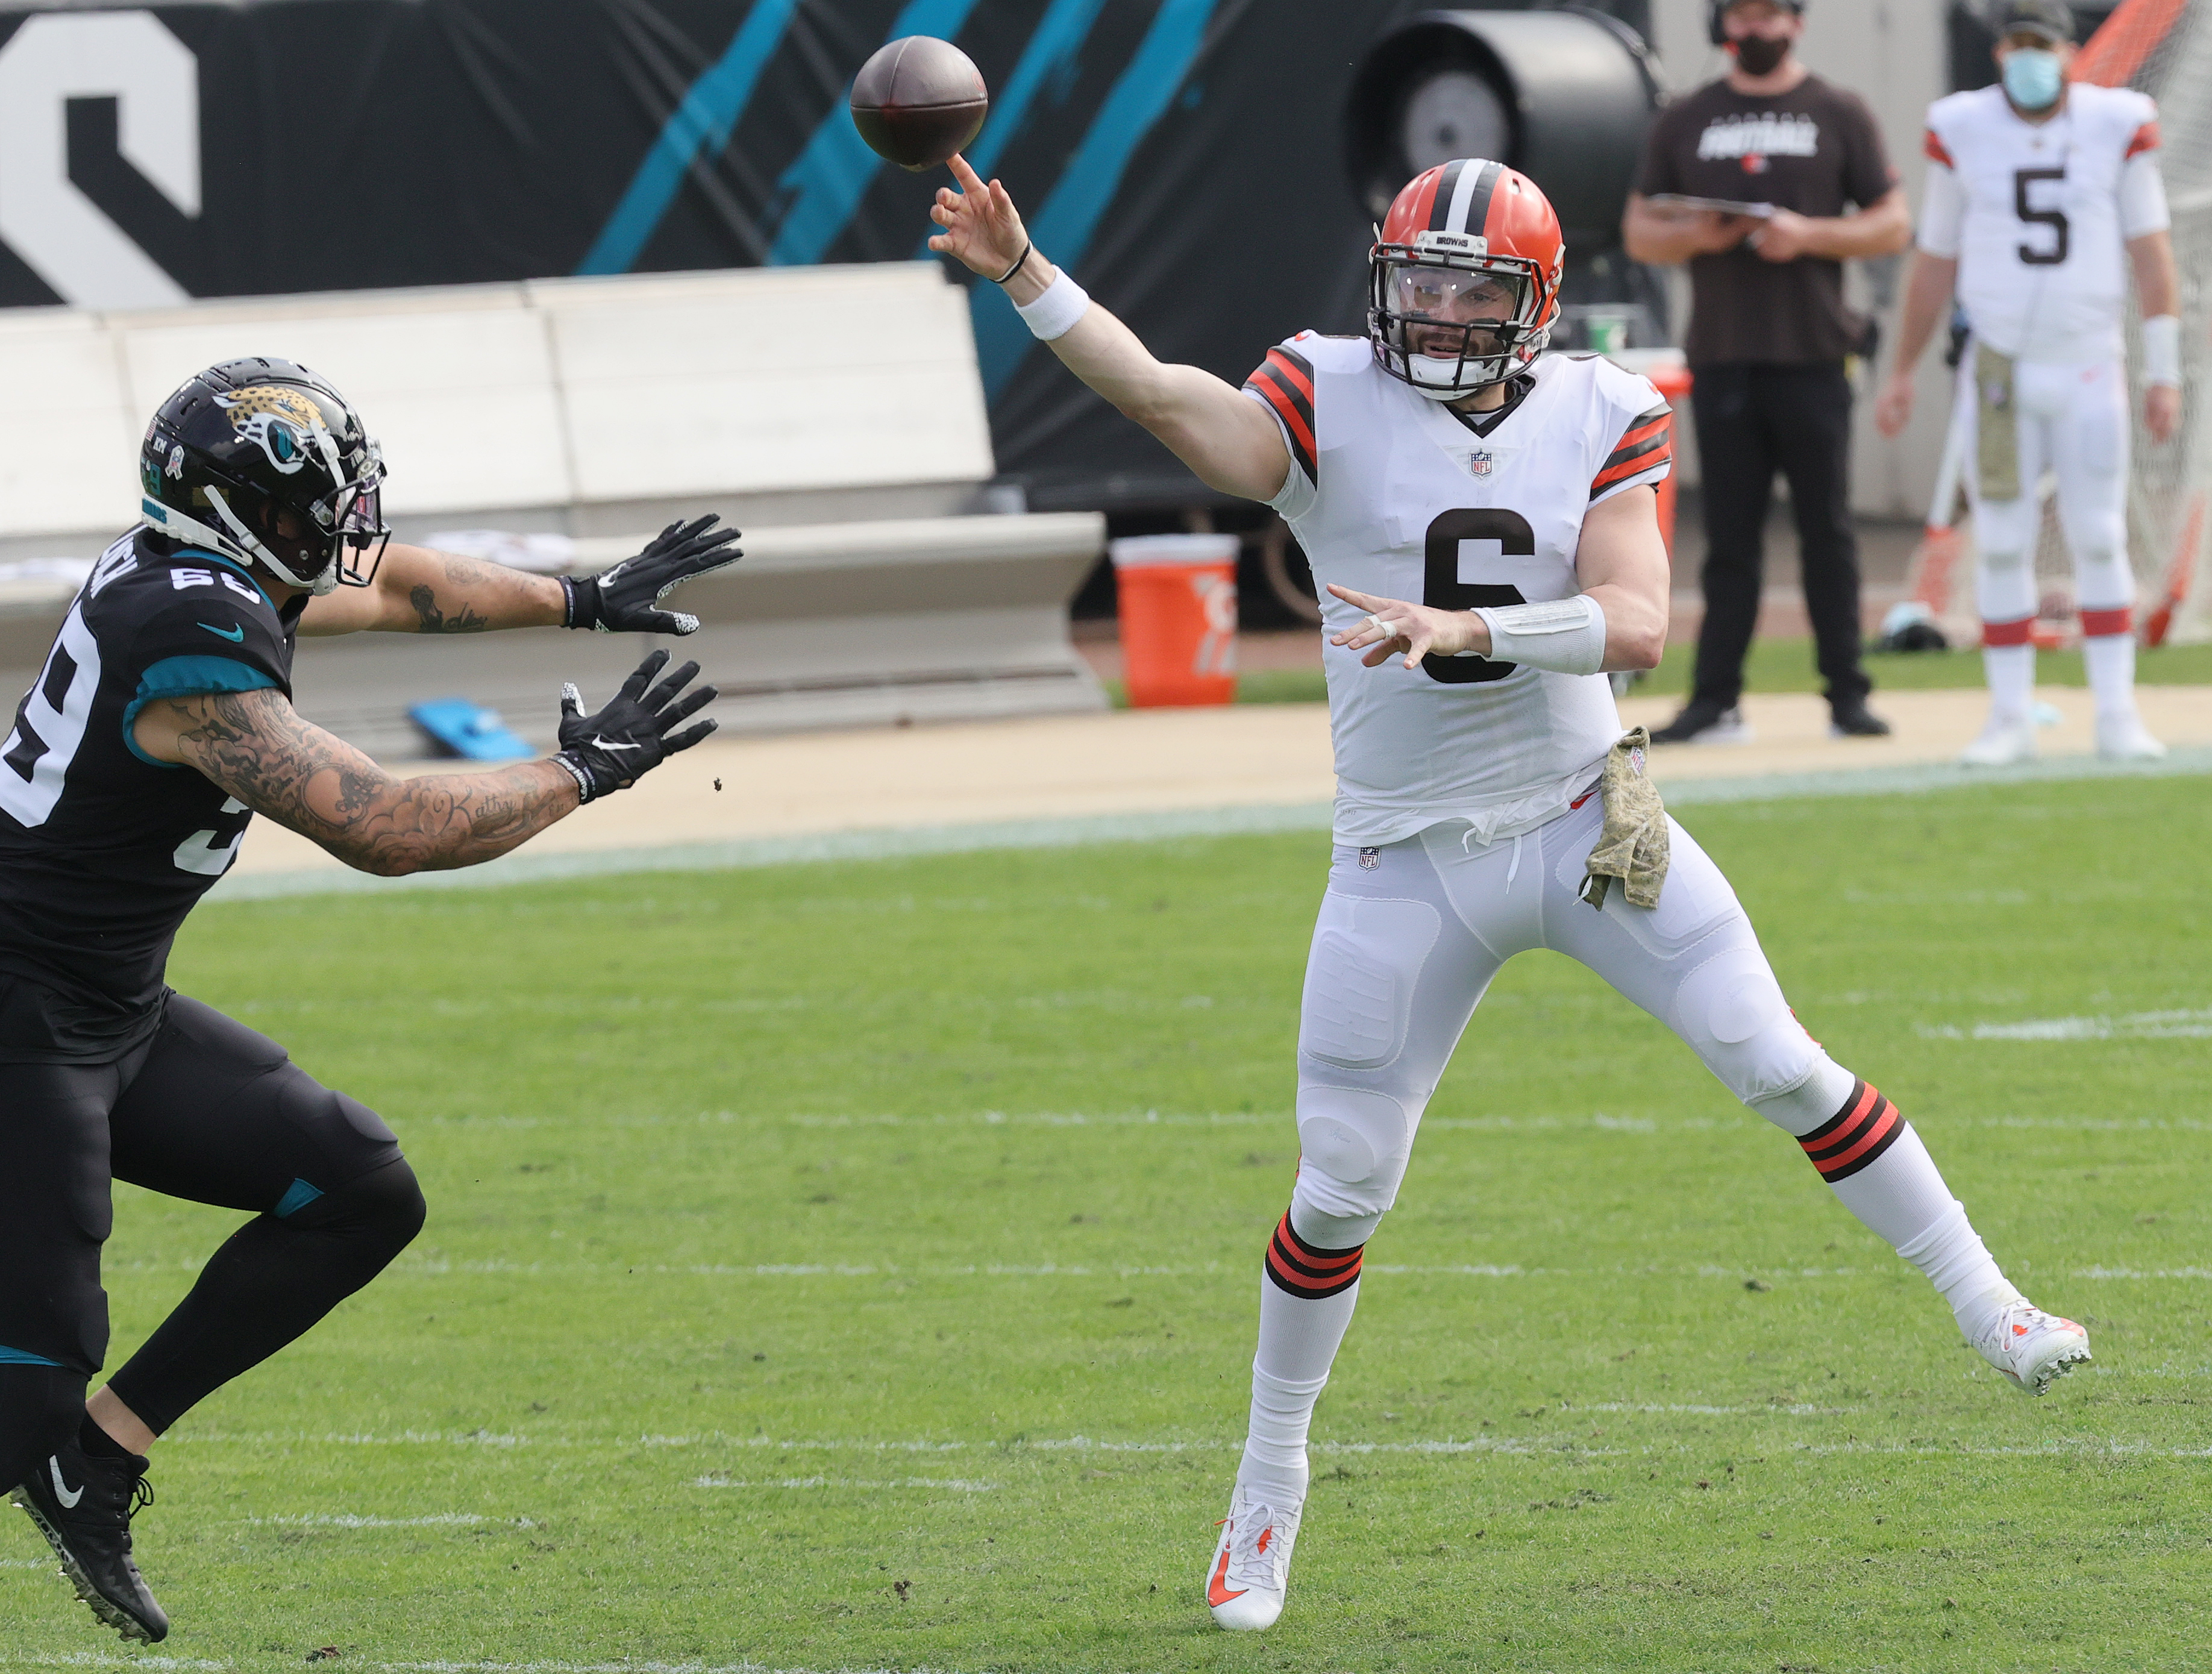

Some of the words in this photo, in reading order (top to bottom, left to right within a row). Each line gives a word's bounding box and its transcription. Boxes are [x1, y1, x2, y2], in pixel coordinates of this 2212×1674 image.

[2016, 169, 2068, 264] 5
[1437, 236, 1468, 247] BROWNS
[153, 436, 168, 454] KM
[1474, 462, 1490, 472] NFL
[1421, 508, 1535, 683] 6
[1361, 856, 1376, 867] NFL
